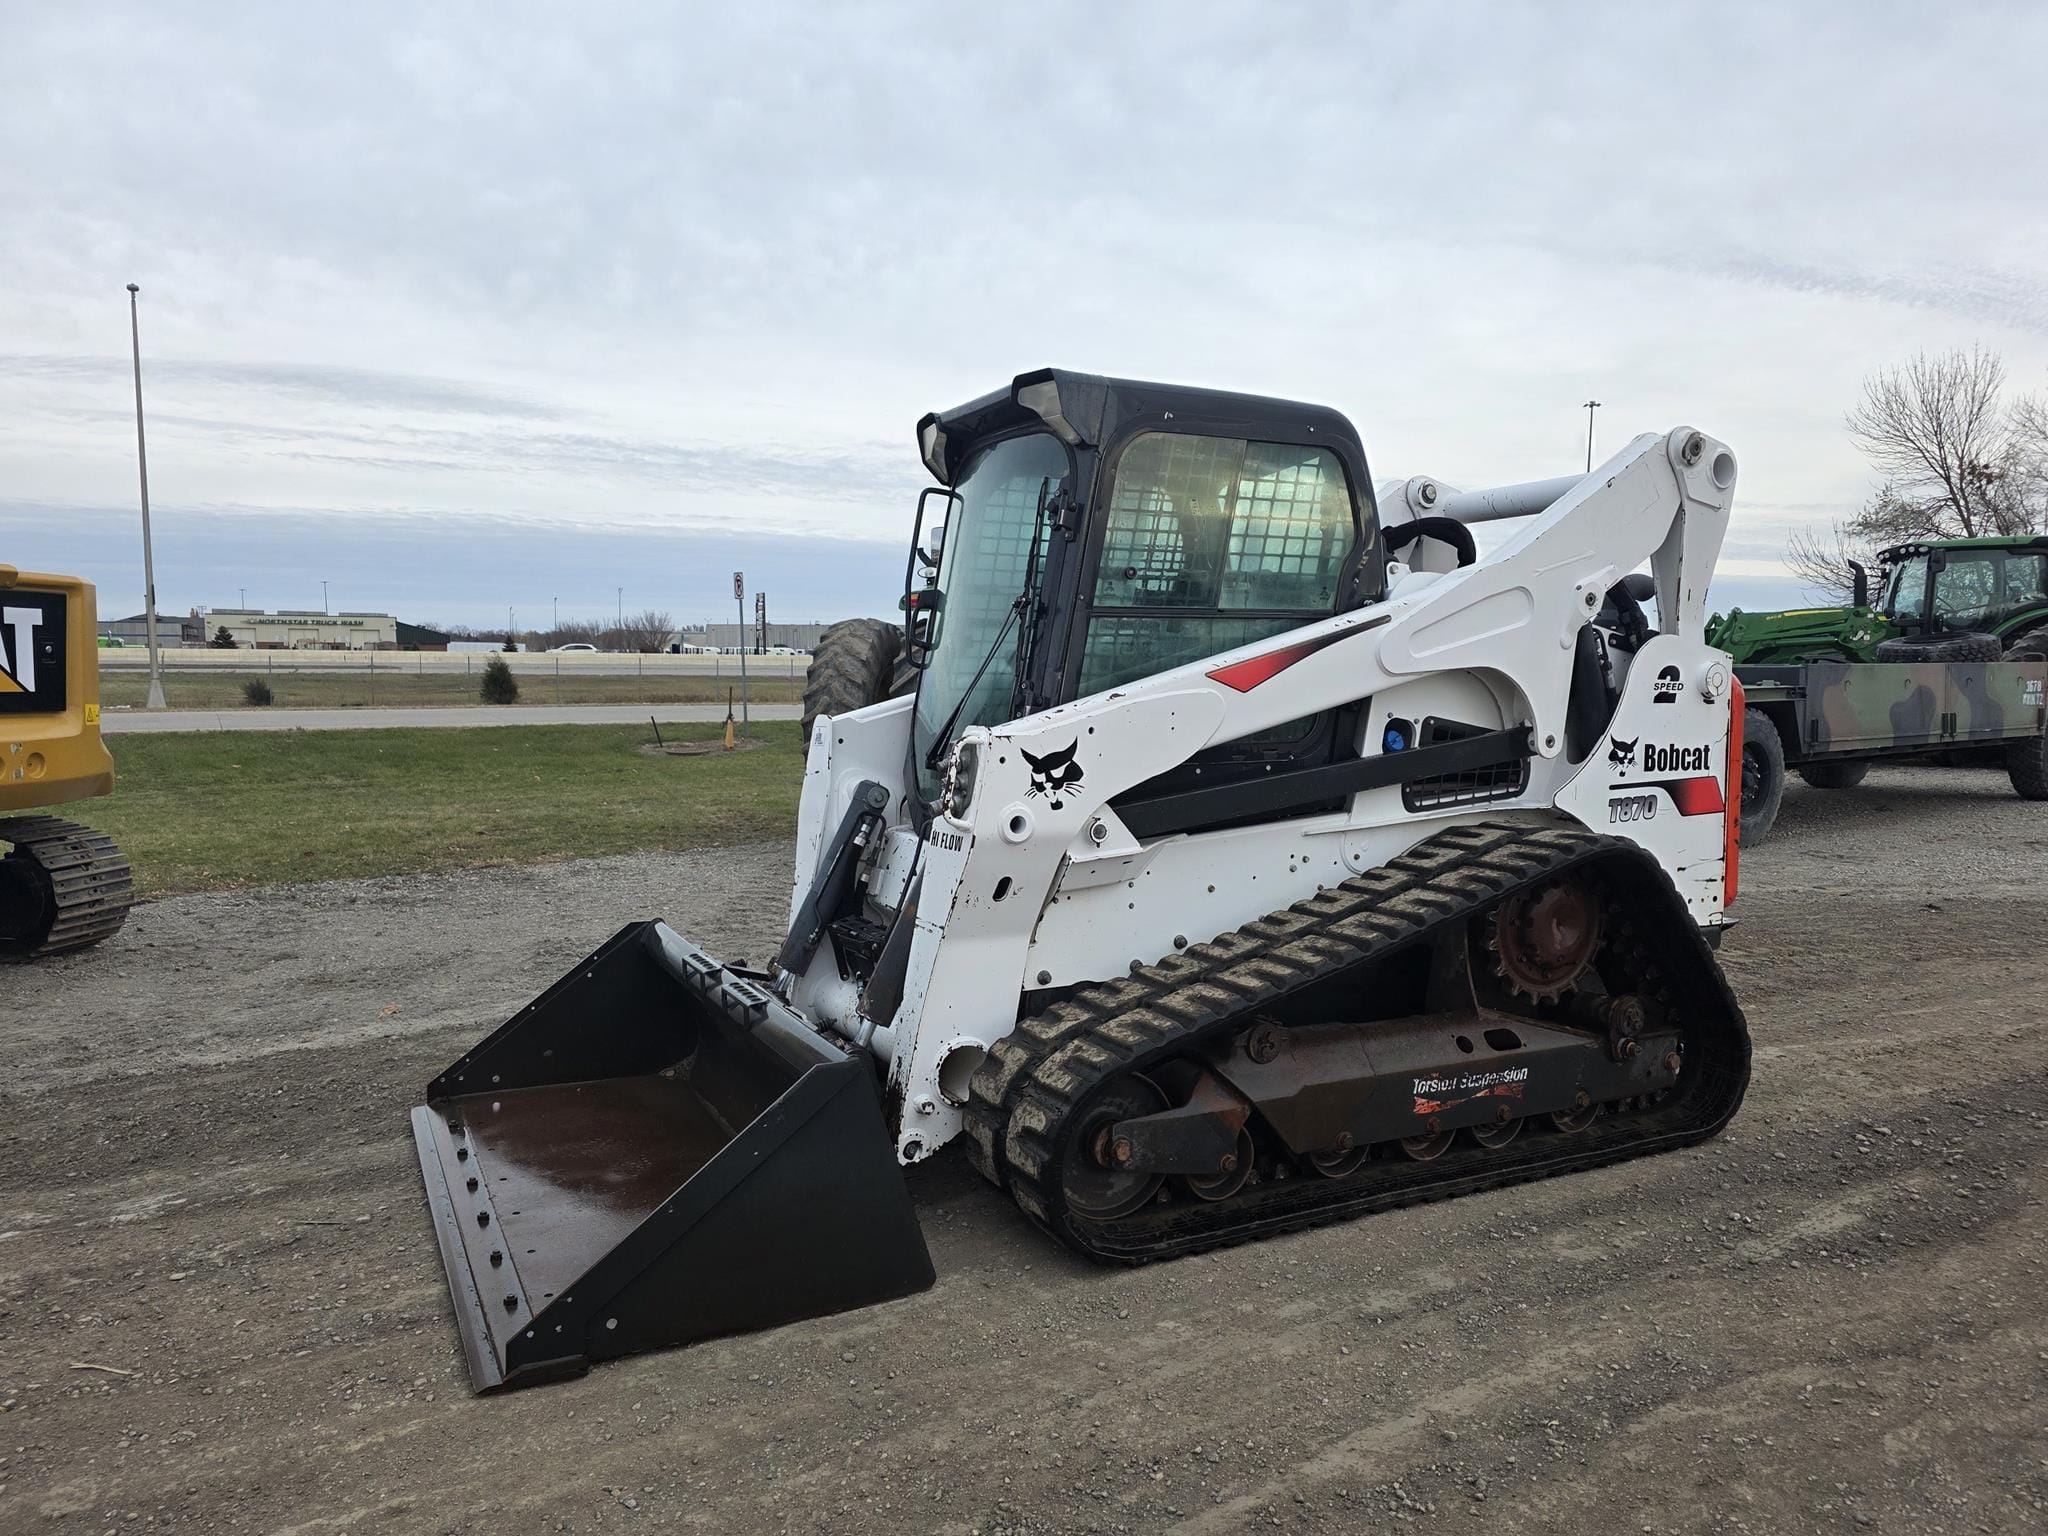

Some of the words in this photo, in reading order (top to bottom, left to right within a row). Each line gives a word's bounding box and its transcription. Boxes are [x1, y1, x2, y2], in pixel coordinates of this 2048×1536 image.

[1653, 665, 1681, 704] 2
[1653, 682, 1684, 691] SPEED
[1643, 743, 1711, 772] Bobcat
[1608, 794, 1658, 823] T870
[930, 830, 940, 847] HI
[940, 832, 964, 852] FLOW
